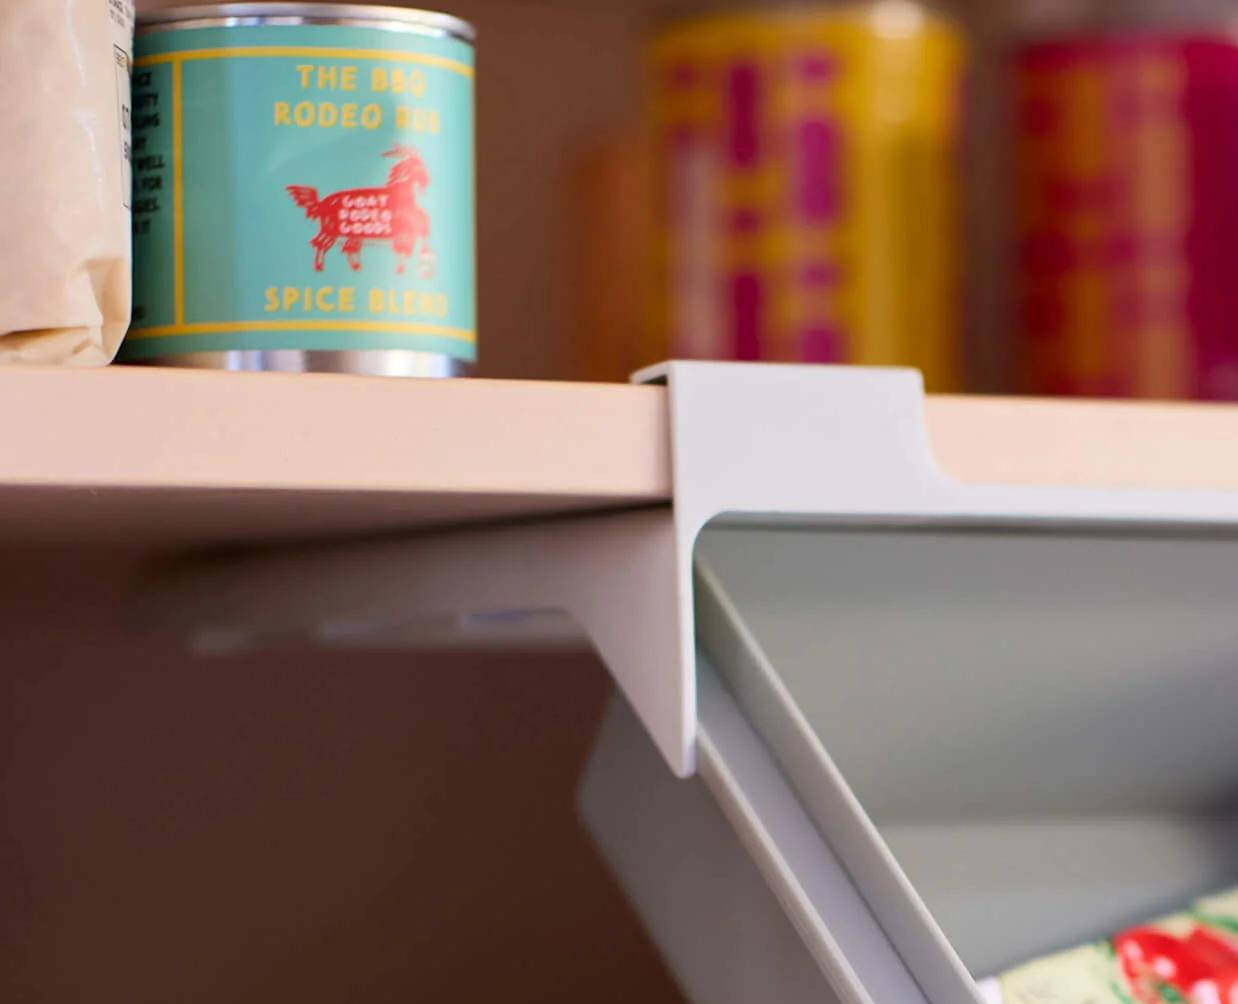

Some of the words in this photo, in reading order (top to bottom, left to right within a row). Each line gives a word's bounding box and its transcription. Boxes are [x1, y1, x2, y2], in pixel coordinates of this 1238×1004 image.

[296, 65, 358, 91] THE
[371, 68, 425, 98] BBQ
[274, 101, 382, 129] RODEO
[342, 194, 389, 208] GOAT
[340, 221, 392, 235] GOODS
[264, 286, 355, 312] SPICE
[369, 288, 448, 318] BLEND
